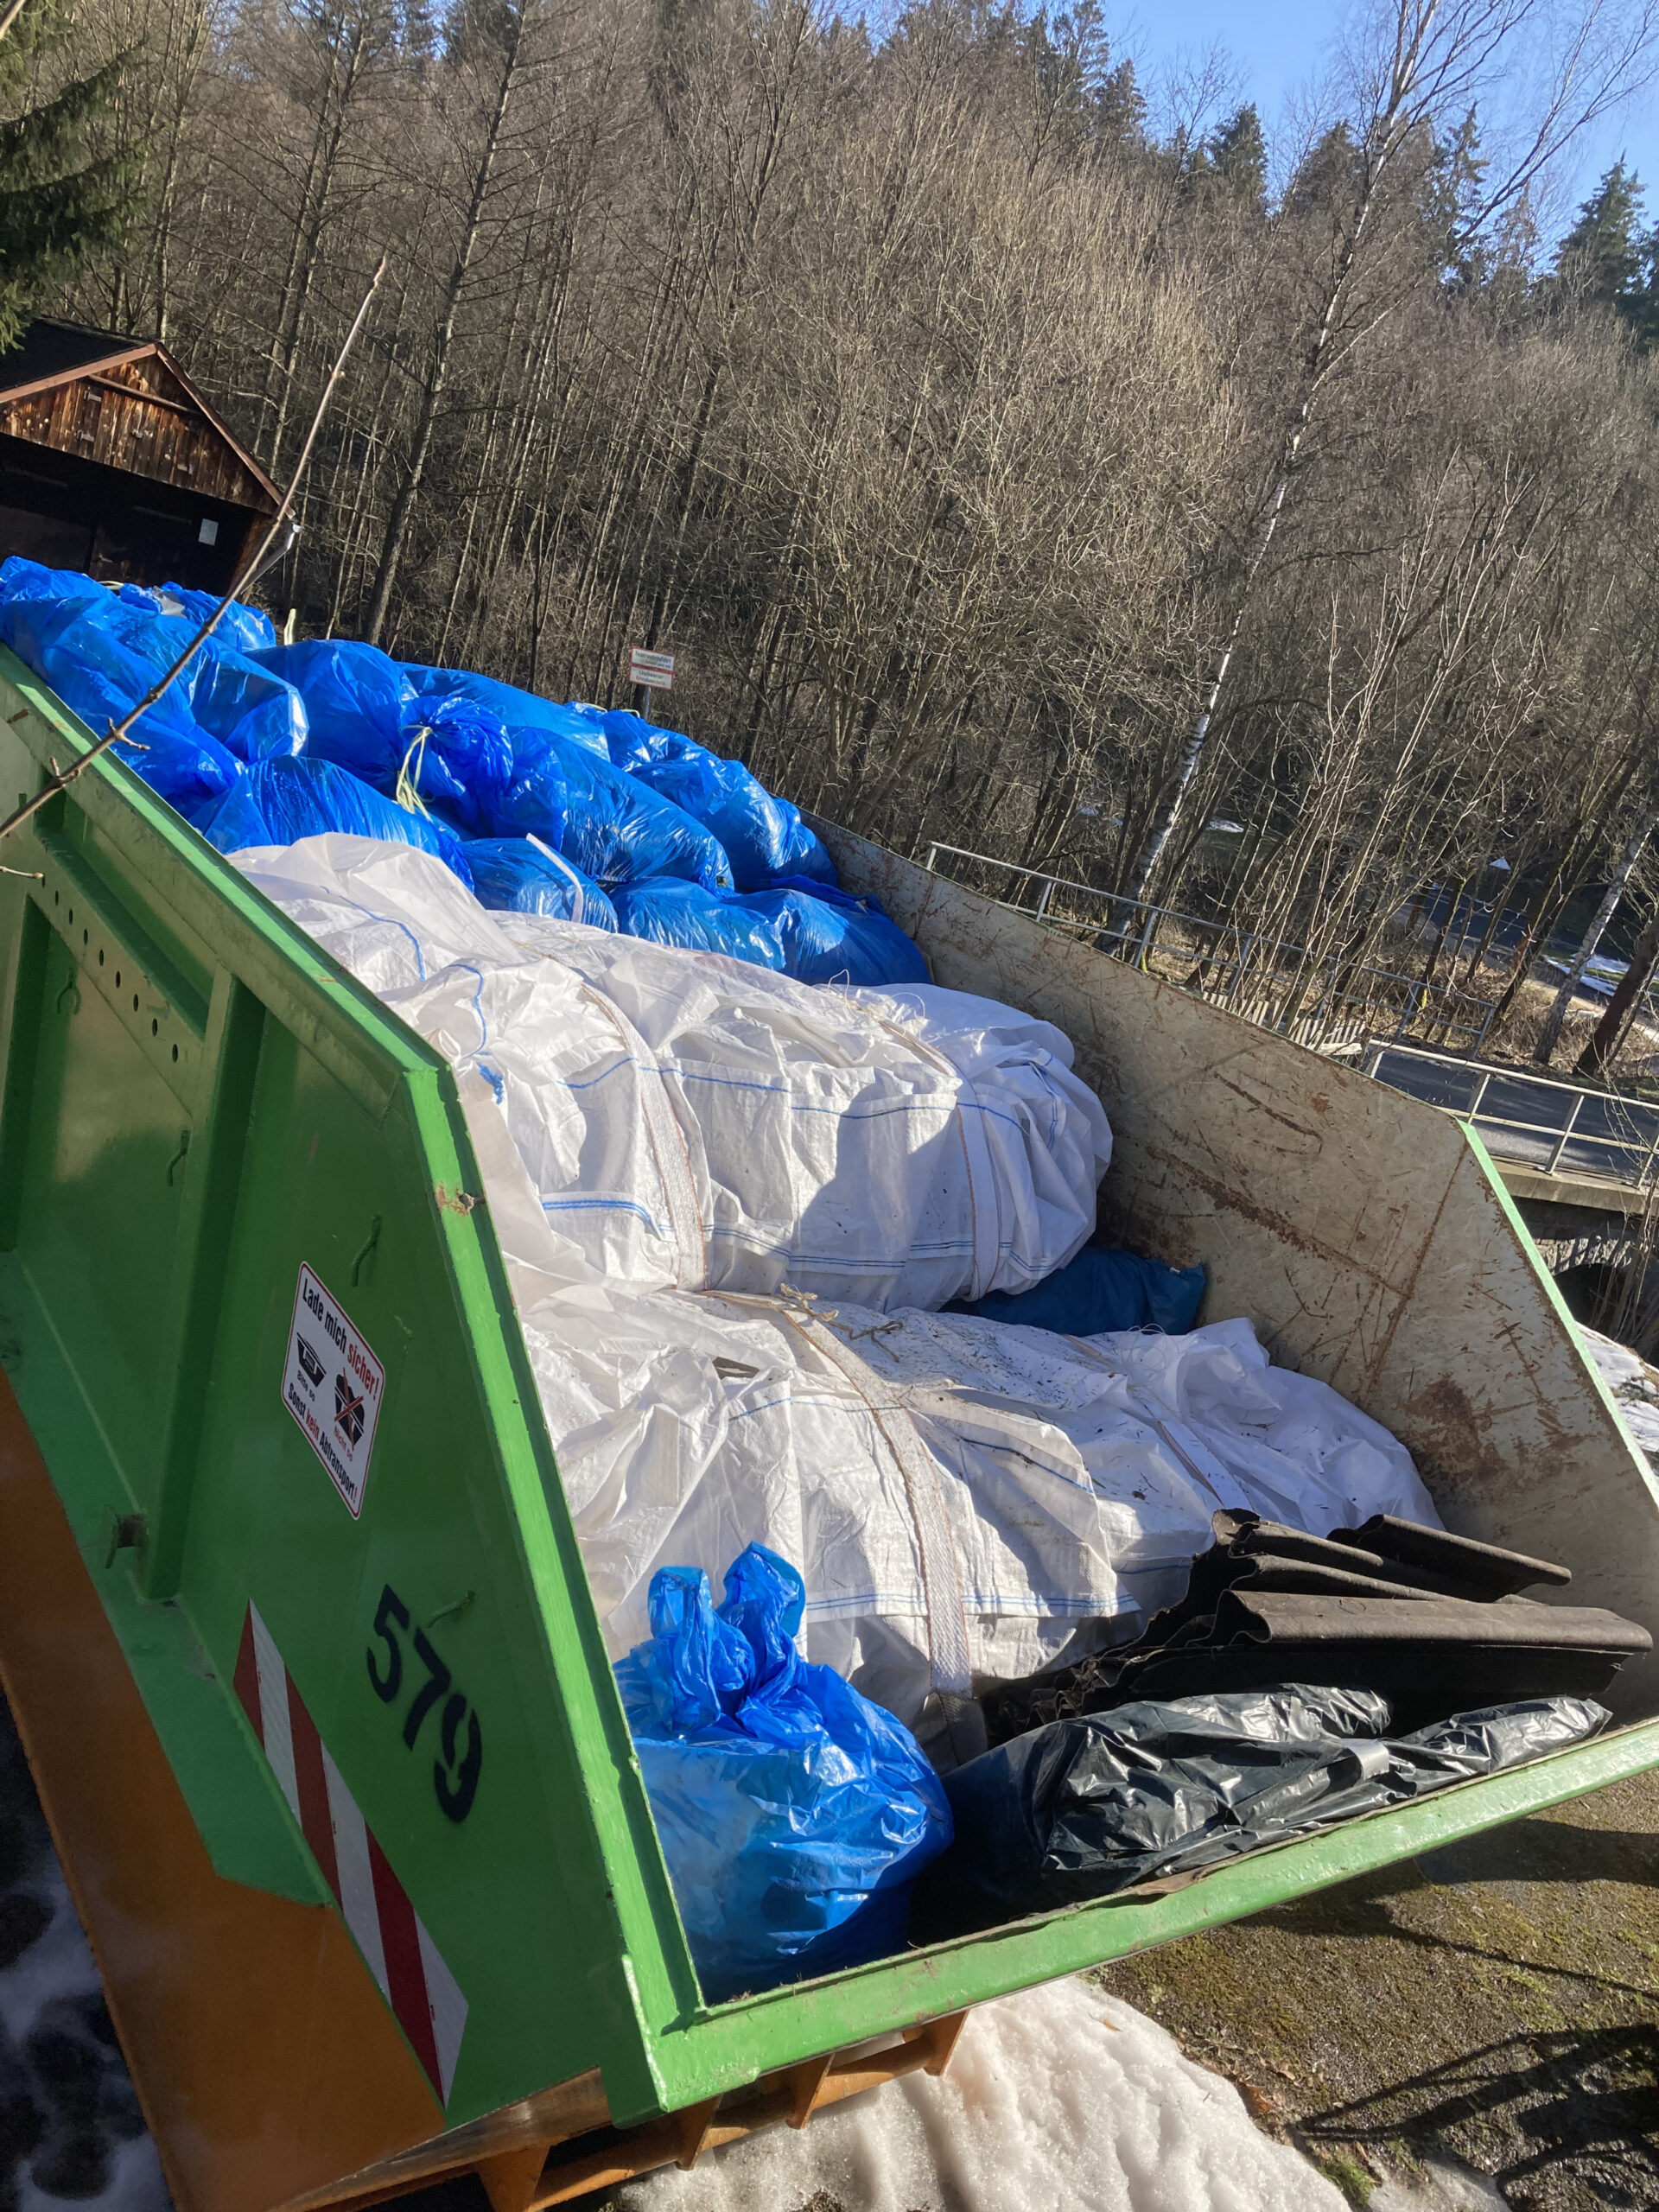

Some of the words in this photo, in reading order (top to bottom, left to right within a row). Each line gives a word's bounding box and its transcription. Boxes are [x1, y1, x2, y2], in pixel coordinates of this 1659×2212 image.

[297, 1370, 308, 1391] Bitte
[308, 1389, 315, 1402] so
[302, 1277, 324, 1322] Lade
[324, 1311, 347, 1354] mich
[347, 1343, 379, 1401] sicher!
[288, 1382, 306, 1419] Sonst
[305, 1408, 320, 1441] kein
[319, 1431, 358, 1503] Abtransport!
[334, 1425, 347, 1452] Nicht
[346, 1449, 353, 1462] so
[366, 1584, 483, 1824] 579
